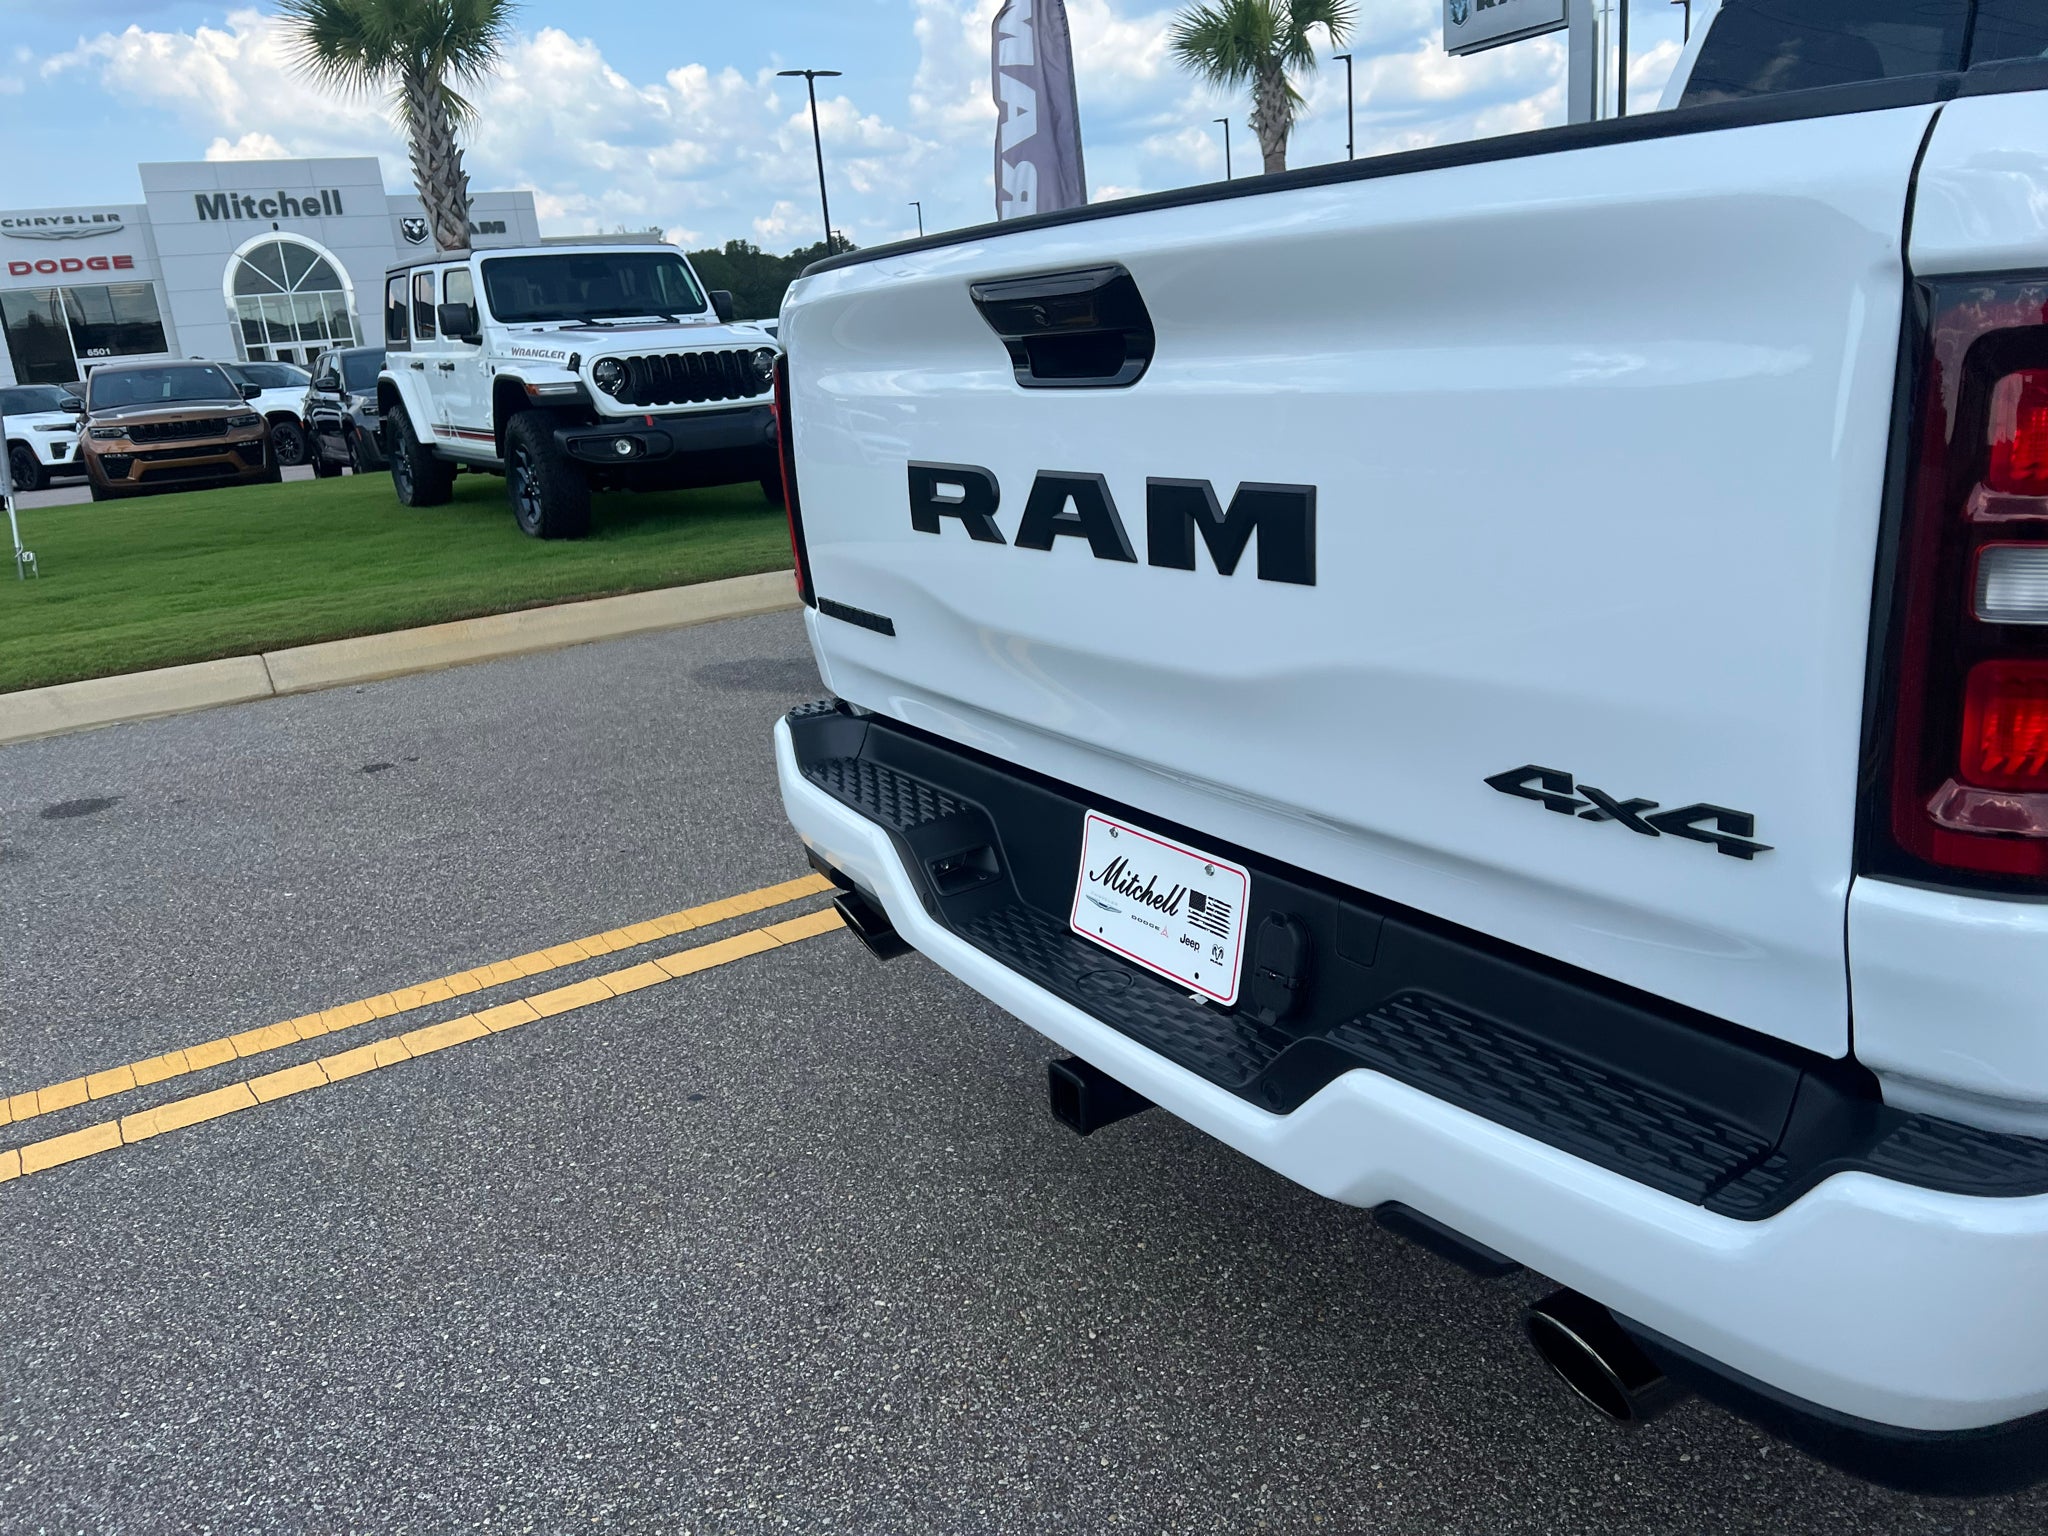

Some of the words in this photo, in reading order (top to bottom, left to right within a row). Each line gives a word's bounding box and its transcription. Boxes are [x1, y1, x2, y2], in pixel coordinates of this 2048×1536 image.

[195, 189, 343, 220] Mitchell
[1, 213, 120, 228] CHRYSLER
[8, 255, 134, 276] DODGE
[87, 347, 112, 357] 6501
[511, 346, 566, 360] WRANGLER
[907, 460, 1317, 587] RAM
[1089, 855, 1187, 917] Mitchell
[1131, 914, 1161, 931] DODGE
[1180, 933, 1200, 951] Jeep
